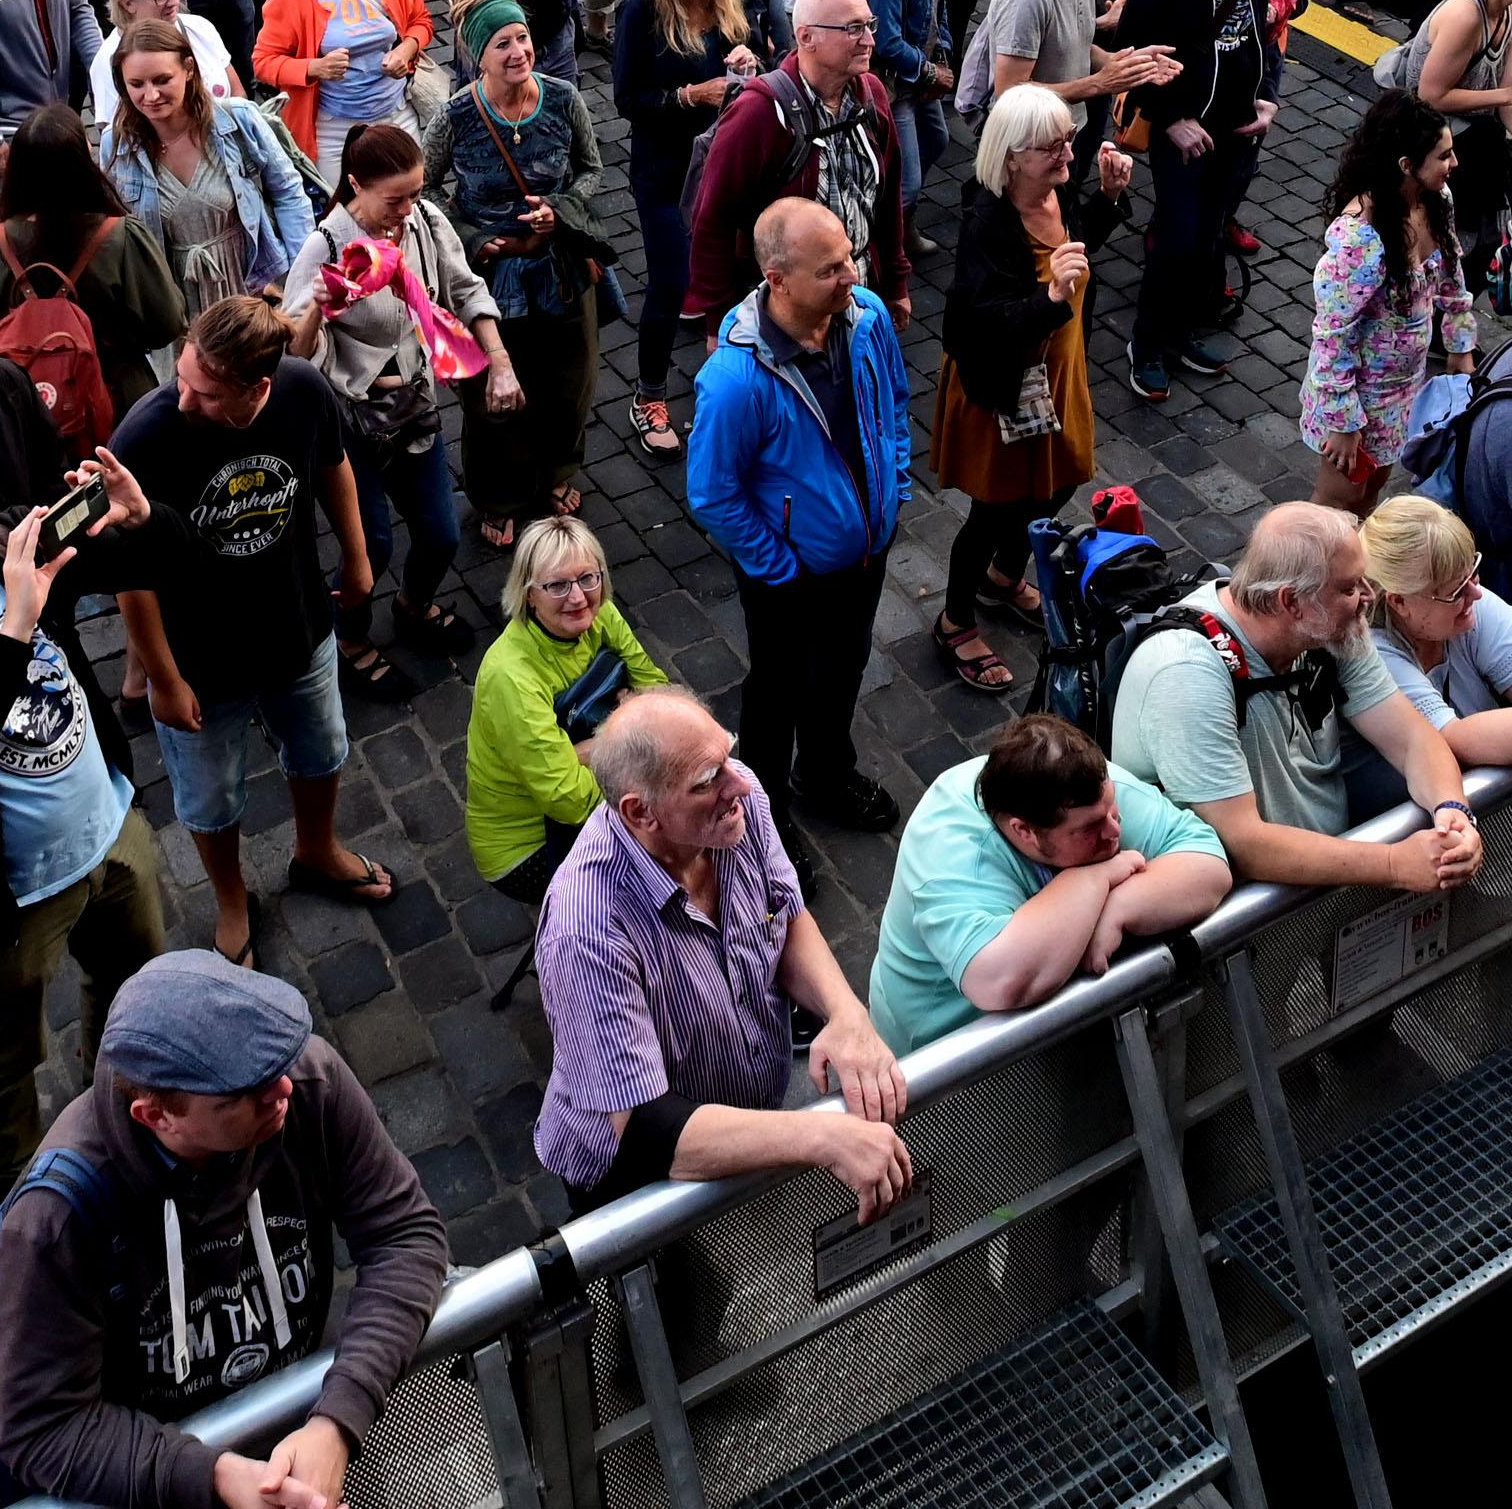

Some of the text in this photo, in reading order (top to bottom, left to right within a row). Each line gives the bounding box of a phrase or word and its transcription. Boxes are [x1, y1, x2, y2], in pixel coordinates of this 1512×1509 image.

[212, 457, 282, 488] CHRONISCH TOTAL
[190, 477, 299, 528] Unterhopft
[221, 532, 274, 554] SINCE EVER
[1412, 902, 1444, 933] BOS
[190, 1285, 224, 1315] FINDING
[184, 1375, 213, 1398] WEAR
